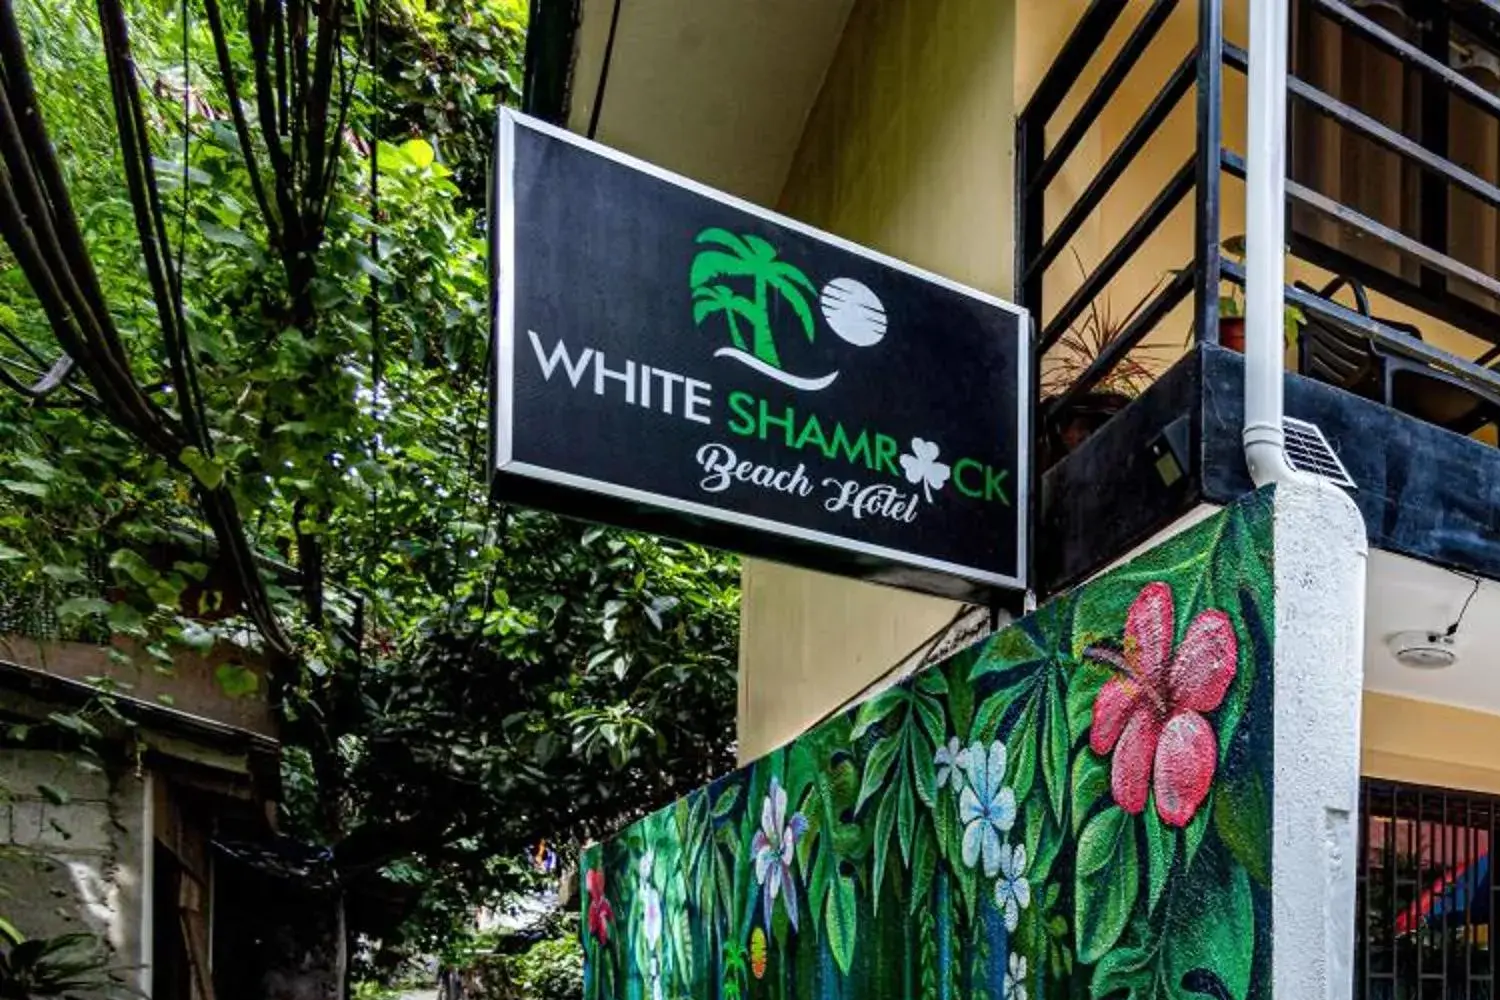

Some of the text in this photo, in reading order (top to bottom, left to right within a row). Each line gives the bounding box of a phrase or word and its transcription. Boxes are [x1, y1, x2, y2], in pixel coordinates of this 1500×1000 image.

[528, 329, 711, 424] WHITE
[695, 443, 919, 523] Beach Hotel
